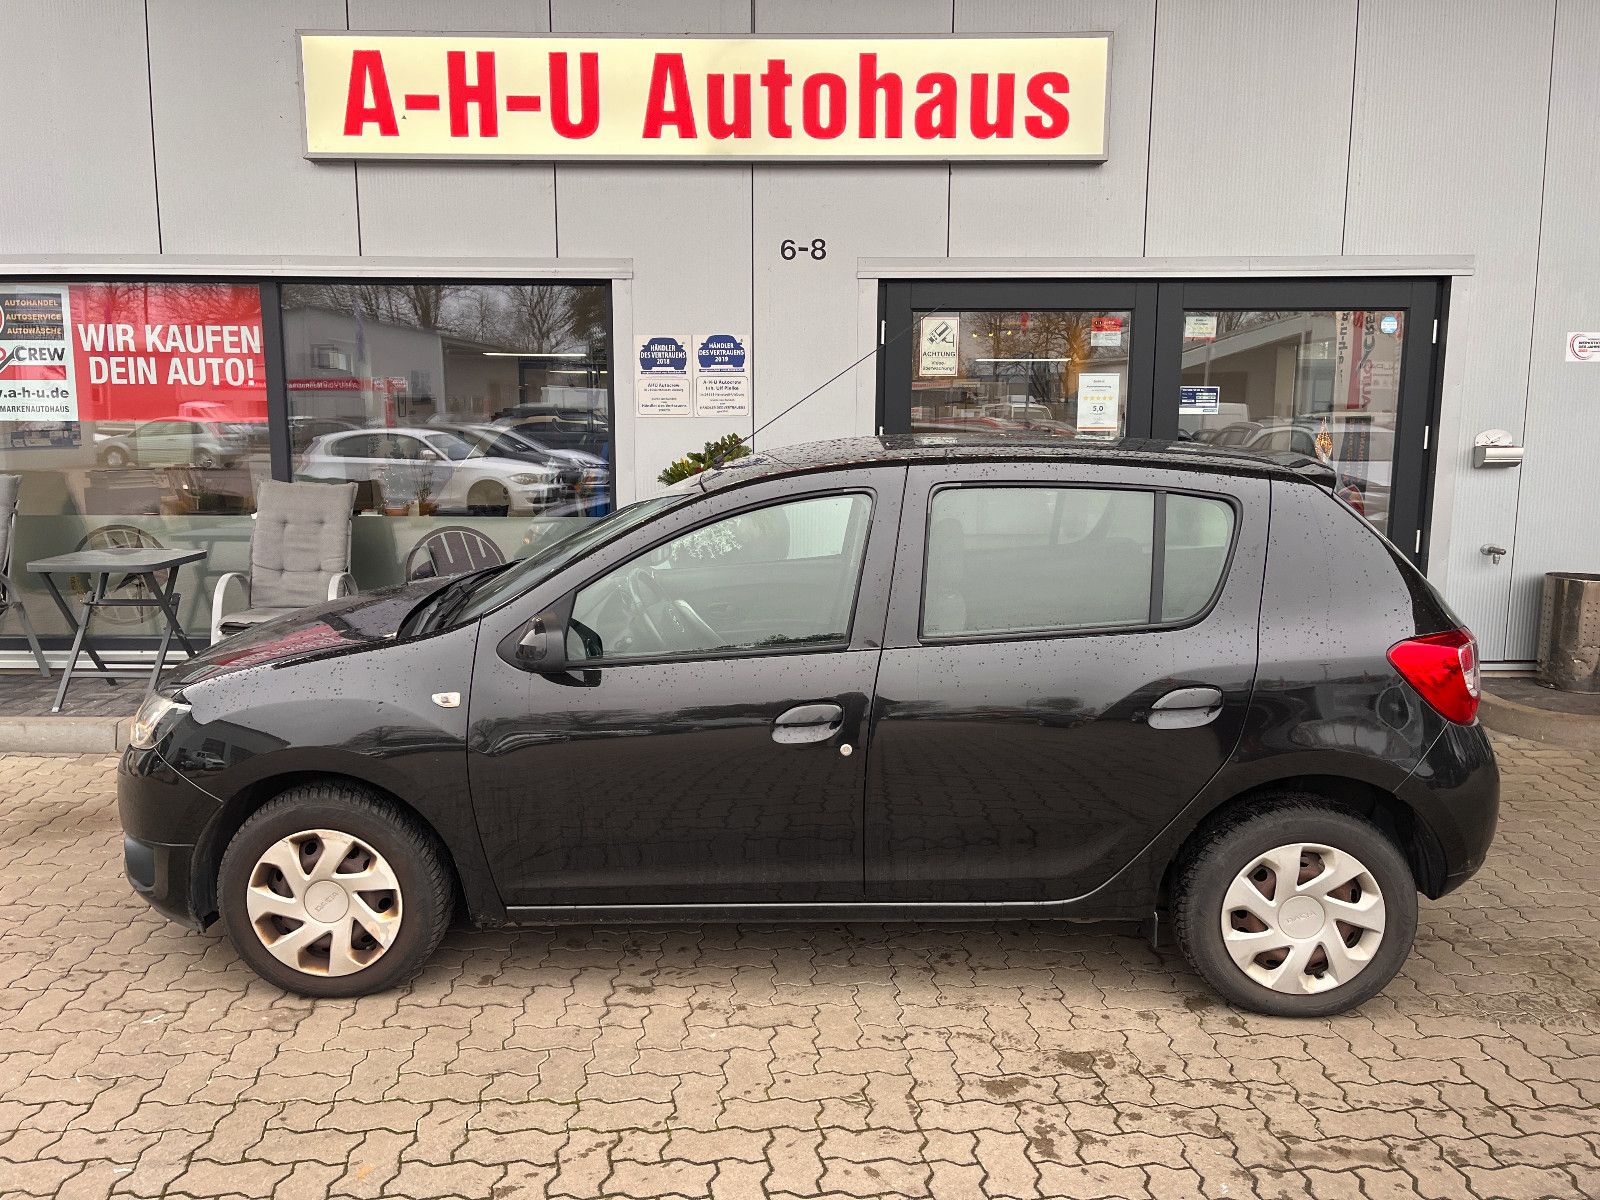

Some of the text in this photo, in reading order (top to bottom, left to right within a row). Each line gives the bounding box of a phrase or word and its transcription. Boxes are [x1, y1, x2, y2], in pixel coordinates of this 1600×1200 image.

[343, 49, 1072, 140] A-H-U Autohaus
[781, 239, 826, 260] 6-8
[6, 313, 62, 321] AUTOSERVICE
[77, 323, 261, 354] WIR KAUFEN
[14, 345, 66, 361] CREW
[640, 351, 686, 359] DES VERTRAUENS
[650, 343, 676, 352] HÄNDLER
[88, 356, 255, 386] DEIN AUTO!
[0, 386, 69, 399] .a-h-u.de
